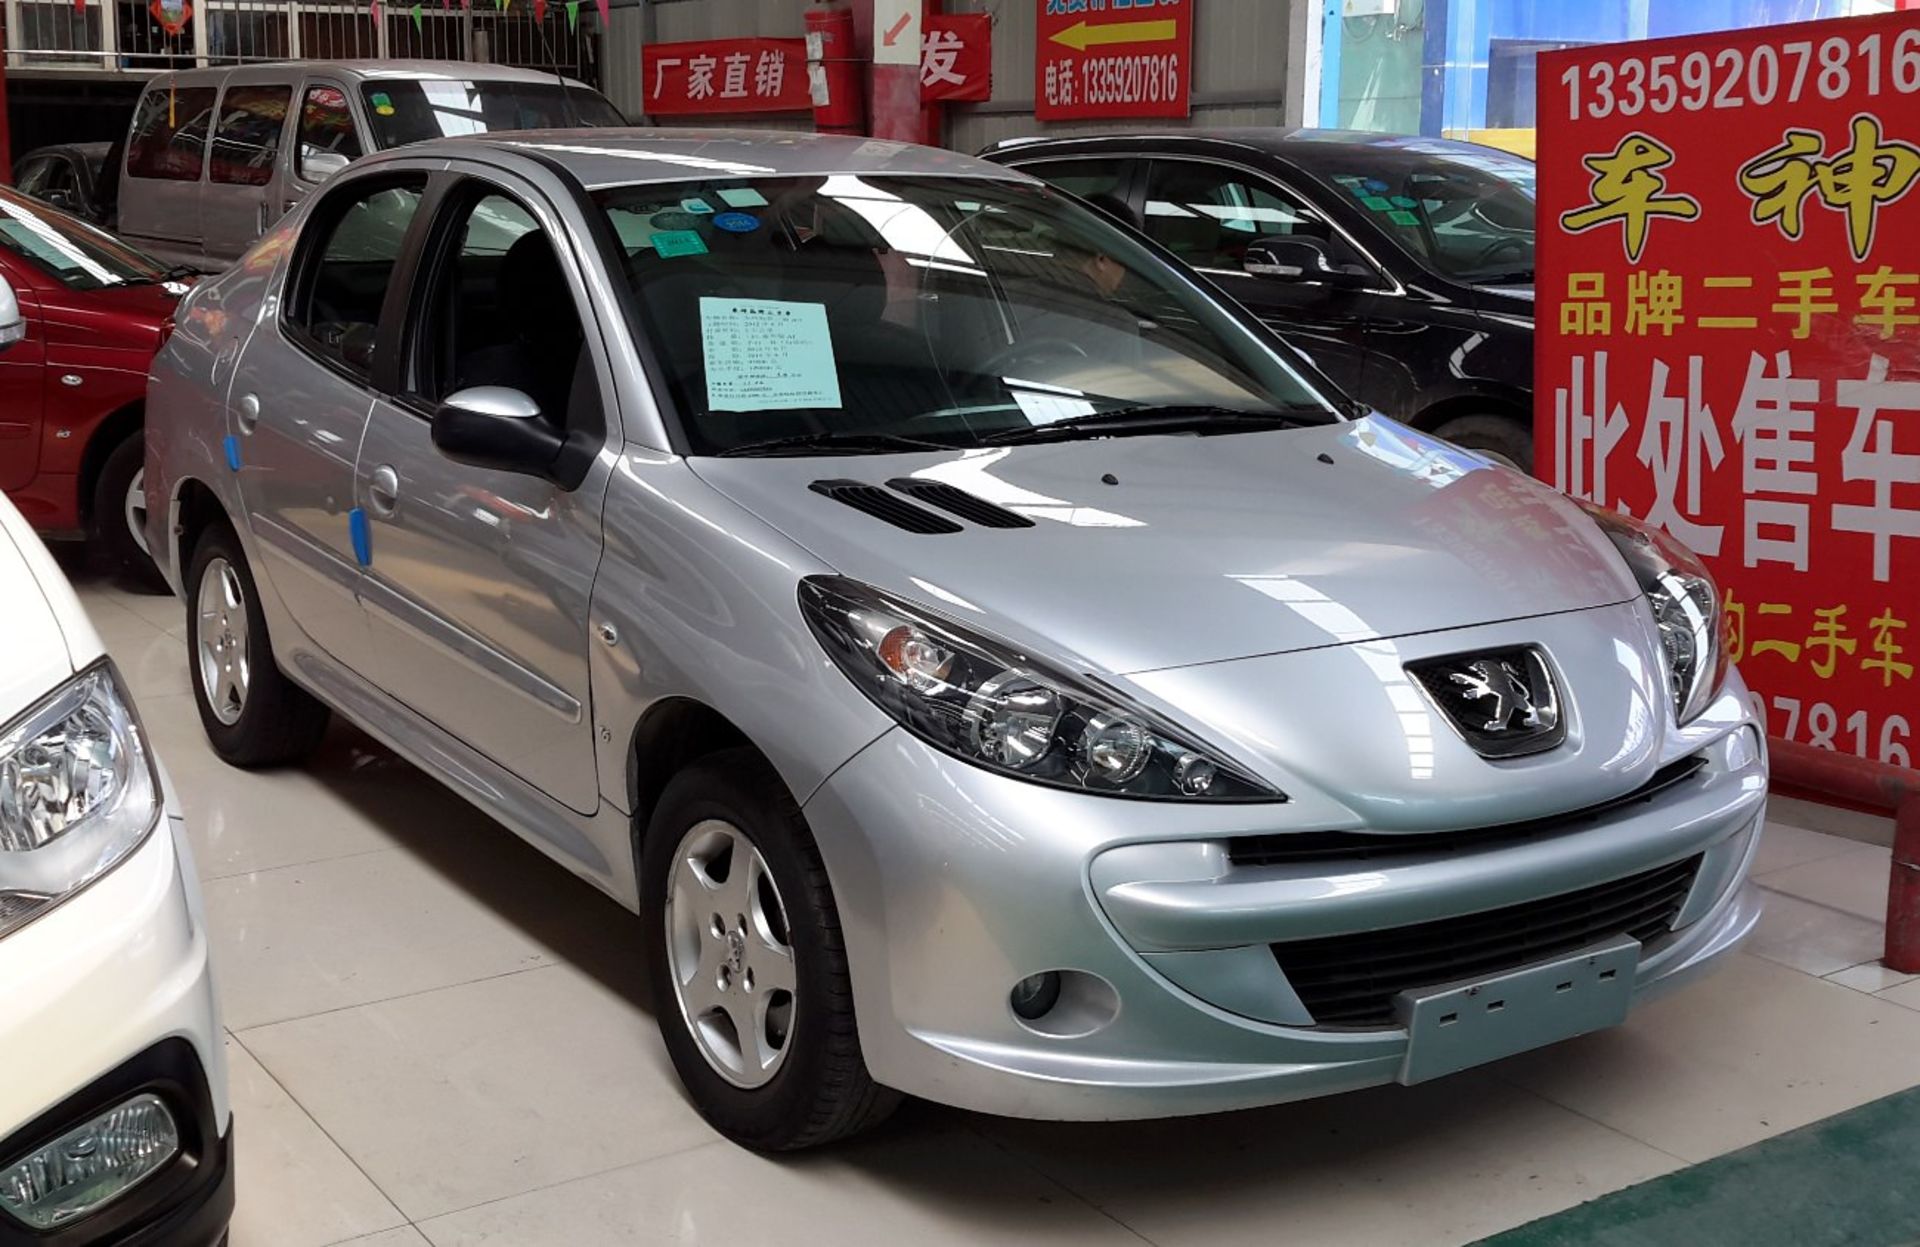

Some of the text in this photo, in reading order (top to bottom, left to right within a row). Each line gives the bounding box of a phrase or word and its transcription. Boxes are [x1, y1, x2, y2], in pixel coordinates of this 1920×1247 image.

[653, 48, 785, 100] 厂家直销
[920, 30, 967, 87] 发
[1561, 27, 1920, 120] 13359207816
[1559, 112, 1920, 264] 车神
[1559, 266, 1920, 340] 品牌二手车
[1554, 349, 1920, 582] 此处售车
